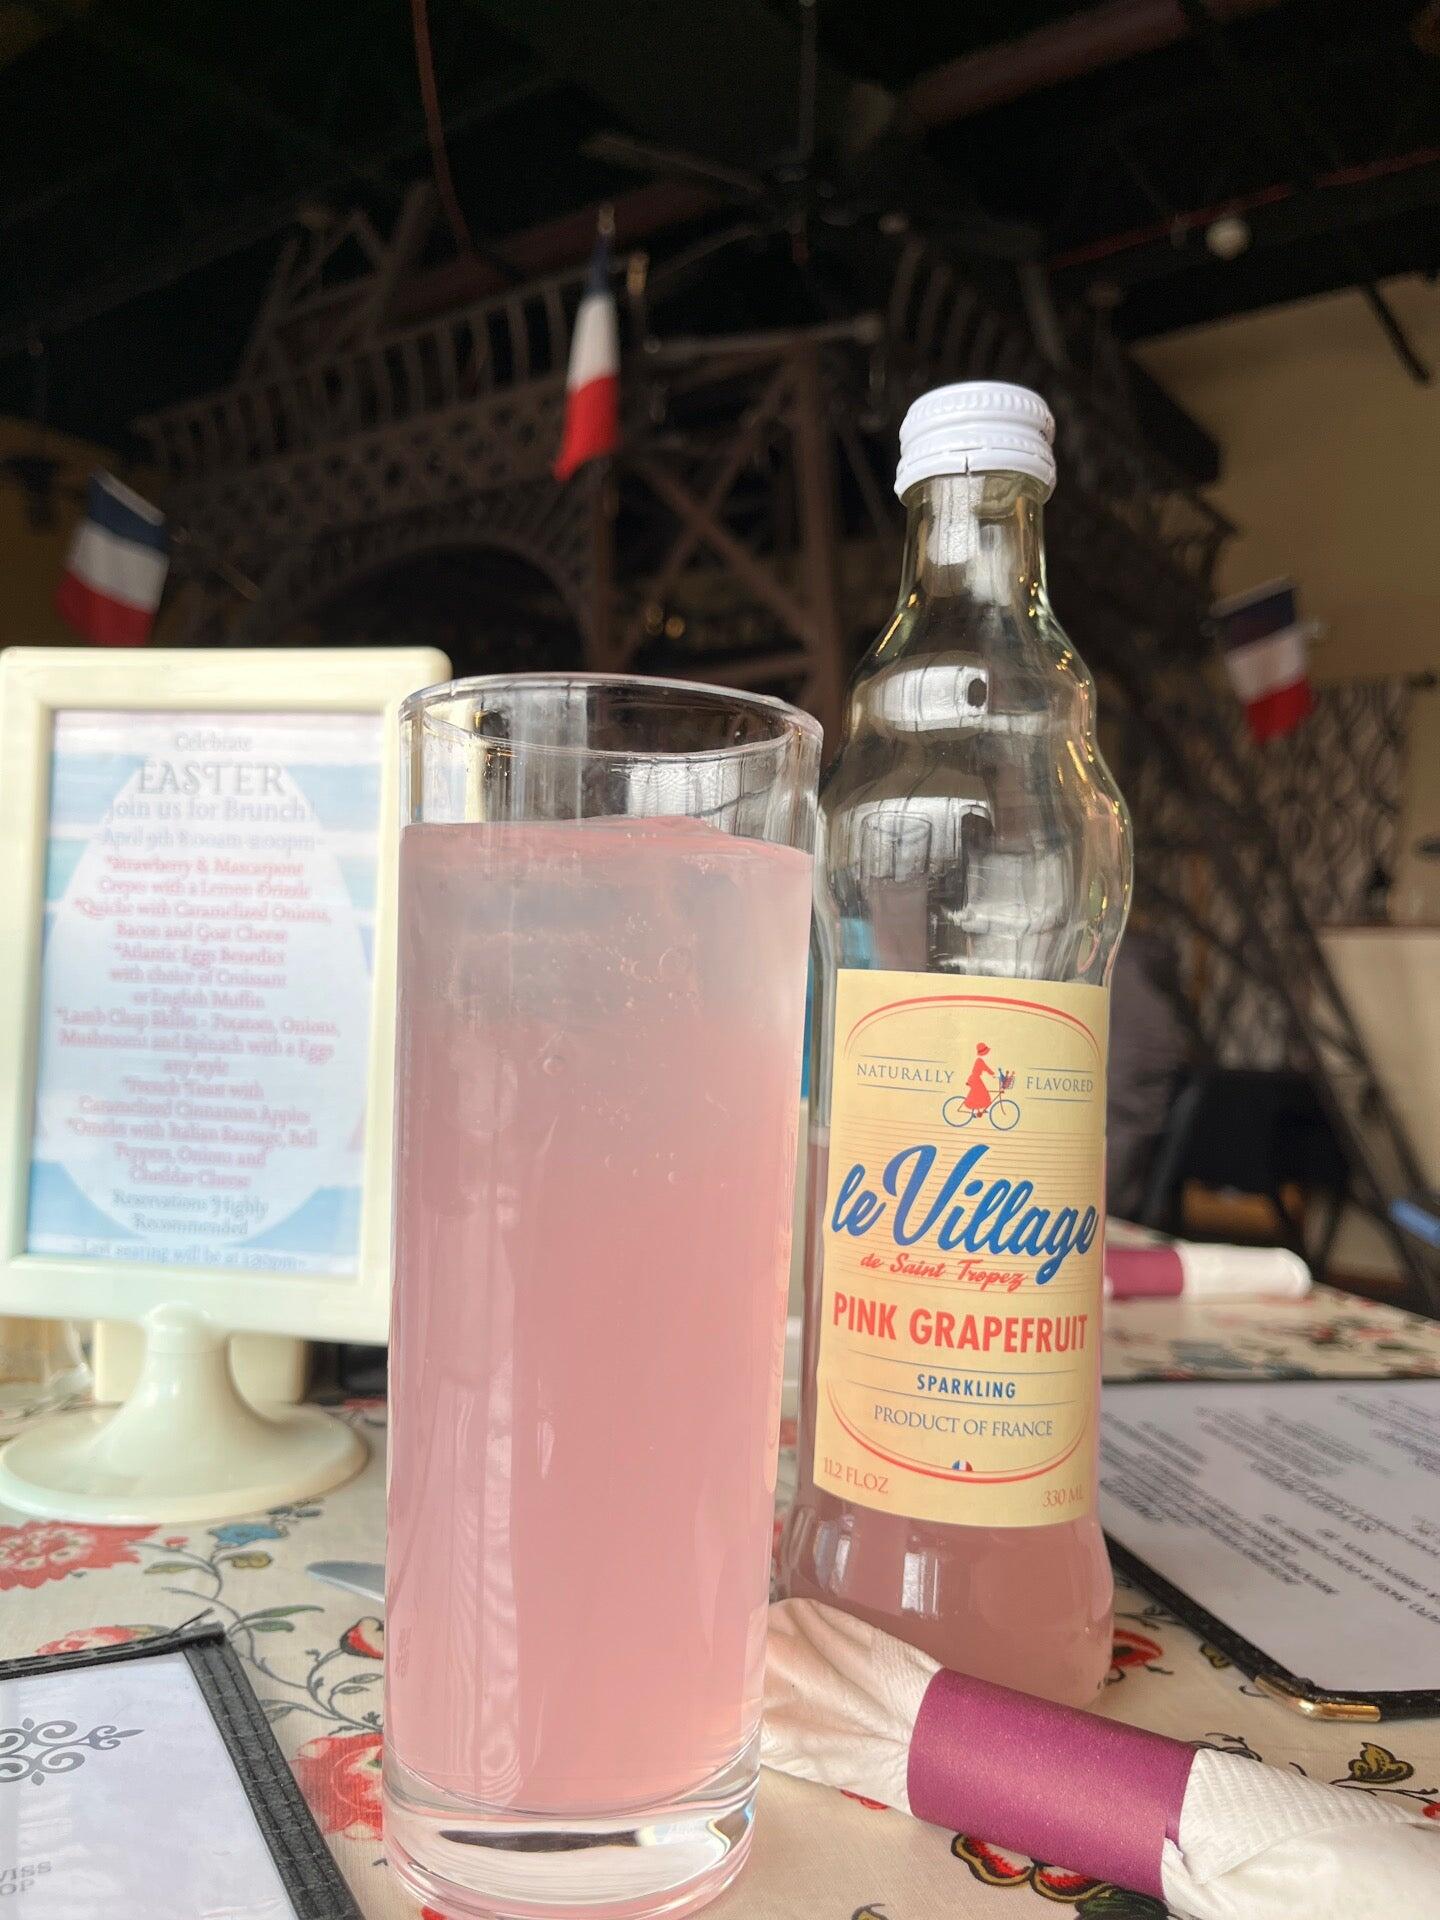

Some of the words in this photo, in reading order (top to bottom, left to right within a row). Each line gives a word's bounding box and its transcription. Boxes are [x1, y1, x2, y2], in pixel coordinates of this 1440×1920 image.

[138, 760, 286, 796] EASTER
[107, 798, 151, 823] Join
[158, 801, 182, 820] us
[188, 797, 217, 820] for
[196, 858, 210, 873] &
[151, 876, 186, 894] with
[136, 897, 173, 915] with
[115, 921, 162, 940] Bacon
[164, 921, 194, 939] and
[196, 922, 236, 945] Goat
[181, 945, 216, 969] Eggs
[220, 947, 286, 967] Benedict
[110, 965, 145, 983] with
[199, 967, 214, 986] of
[217, 967, 288, 989] Croissant
[151, 988, 207, 1011] English
[109, 1007, 148, 1032] Chop
[59, 1028, 149, 1051] Mushrooms
[152, 1031, 181, 1050] and
[184, 1032, 244, 1058] Spinach
[247, 1034, 283, 1057] with
[182, 1078, 226, 1099] Toast
[229, 1078, 264, 1100] with
[856, 1063, 955, 1084] NATURALLY
[1026, 1075, 1094, 1093] FLAVORED
[174, 1100, 257, 1121] Cinnamon
[260, 1102, 312, 1129] Apples
[130, 1118, 166, 1139] with
[168, 1120, 219, 1142] Italian
[288, 1126, 319, 1149] Bell
[236, 1148, 267, 1169] and
[129, 1163, 196, 1185] Cheddar
[198, 1167, 252, 1190] Cheese
[208, 1192, 270, 1224] Highly
[831, 1163, 887, 1237] le
[882, 1143, 1100, 1286] Village
[132, 1211, 249, 1236] Recommended
[860, 1252, 882, 1271] de
[889, 1252, 946, 1279] Saint
[957, 1258, 1028, 1293] Tropez
[832, 1291, 898, 1341] PINK
[908, 1308, 1088, 1353] GRAPEFRUIT
[916, 1373, 1017, 1398] SPARKLING
[873, 1404, 961, 1434] PRODUCT
[963, 1420, 989, 1436] OF
[992, 1419, 1054, 1438] FRANCE
[1041, 1489, 1067, 1508] 330
[1067, 1484, 1085, 1505] ML
